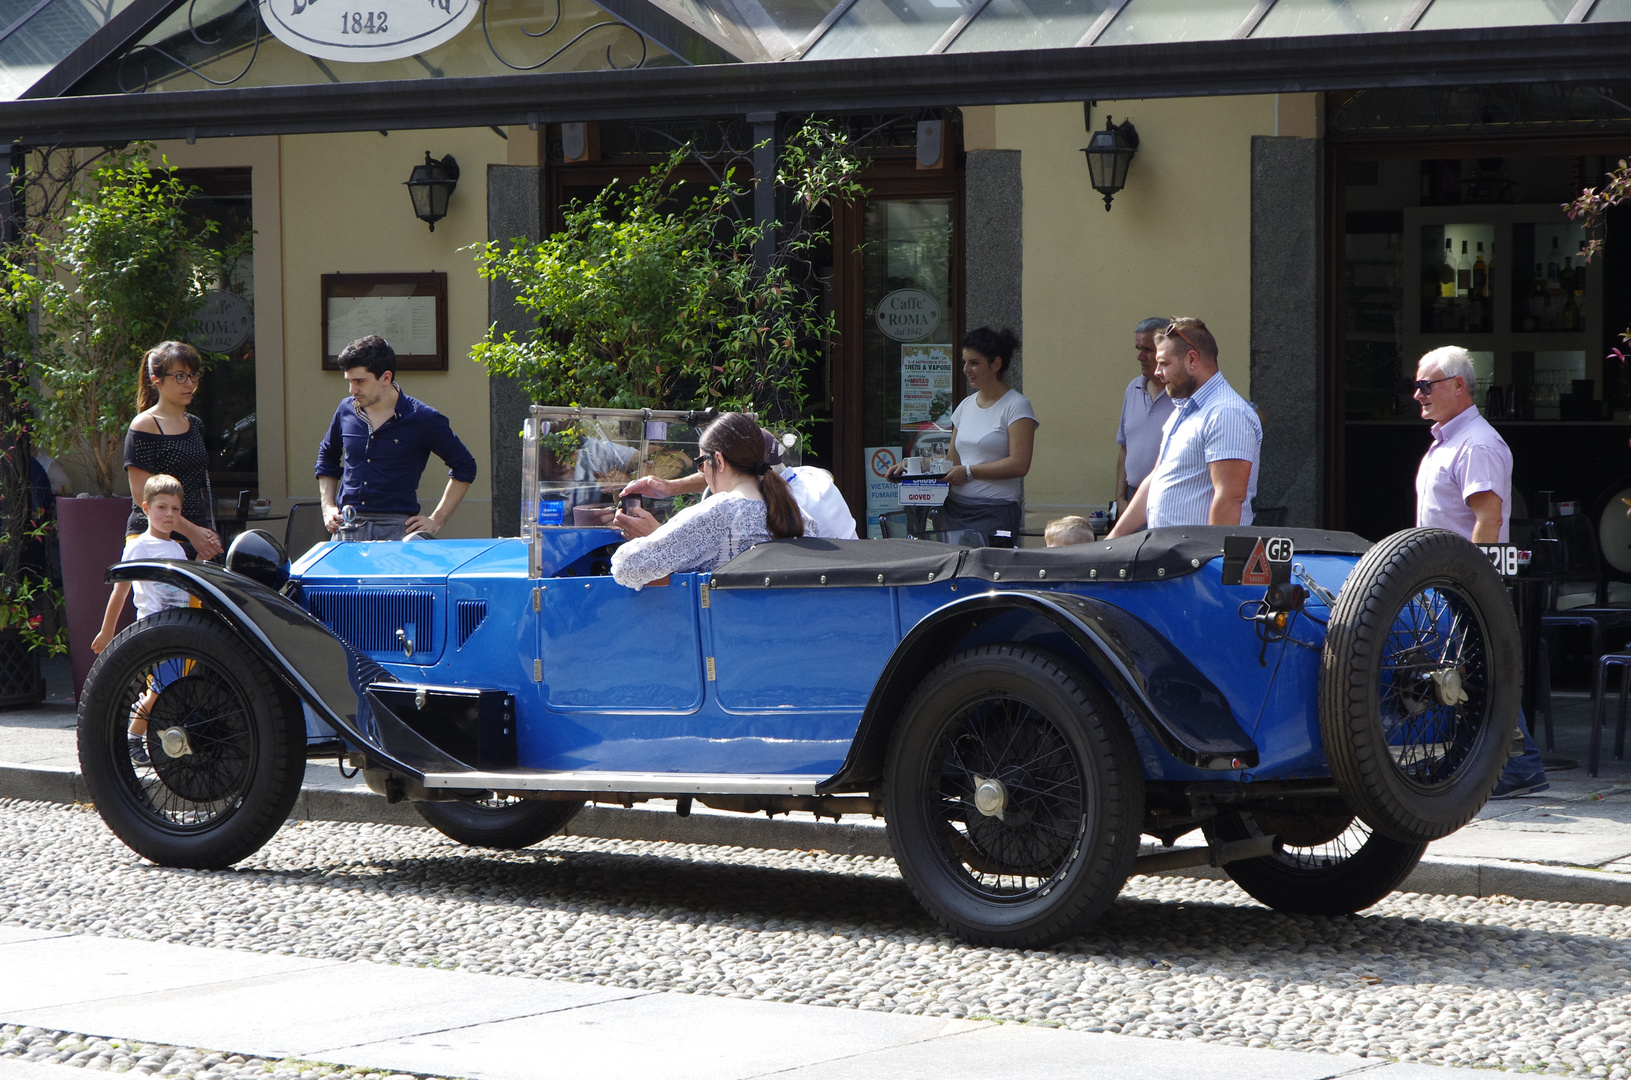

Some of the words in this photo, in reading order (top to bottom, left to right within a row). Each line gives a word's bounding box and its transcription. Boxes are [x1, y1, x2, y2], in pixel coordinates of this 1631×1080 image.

[341, 11, 388, 34] 1842
[890, 297, 926, 310] Caffe'
[888, 313, 928, 326] ROMA
[195, 320, 238, 335] ROMA
[215, 336, 232, 347] 1842
[1268, 539, 1291, 561] GB
[1478, 546, 1518, 576] 218
